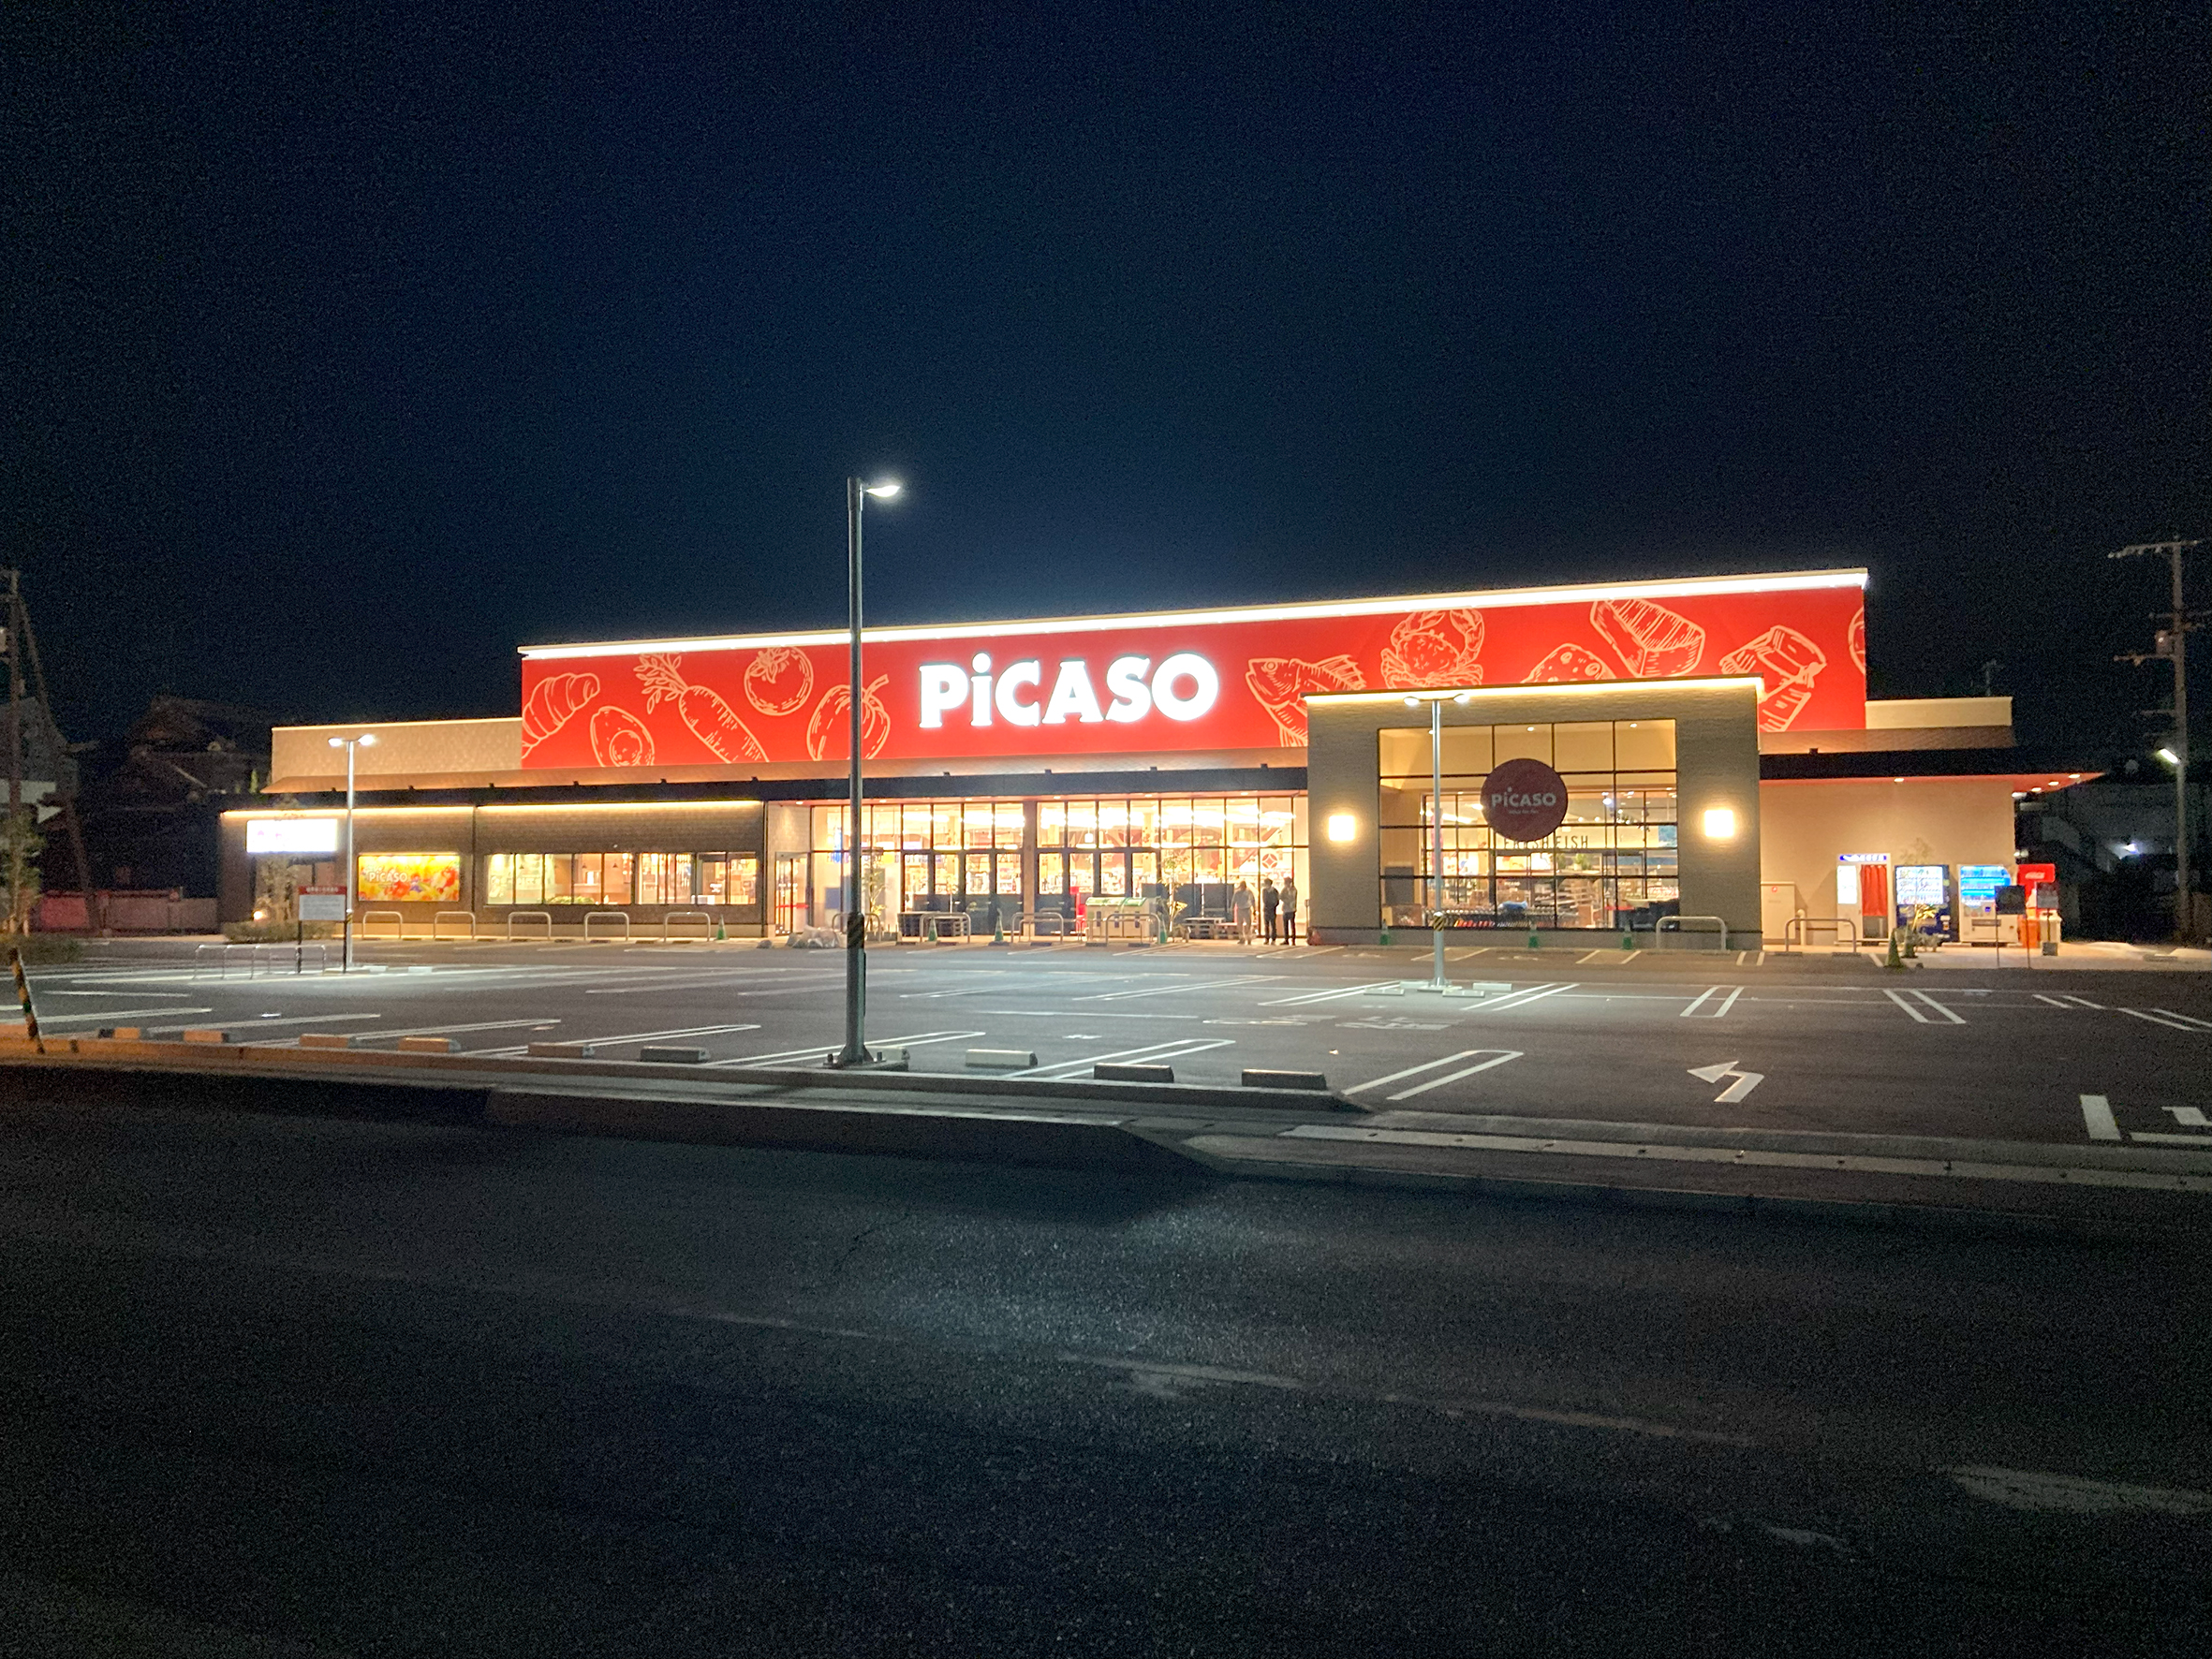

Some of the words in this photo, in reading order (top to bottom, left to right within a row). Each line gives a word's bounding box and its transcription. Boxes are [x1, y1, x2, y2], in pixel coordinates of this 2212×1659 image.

[919, 653, 1218, 728] PiCASO
[1491, 786, 1556, 808] PiCASO
[369, 871, 408, 883] PiCASO
